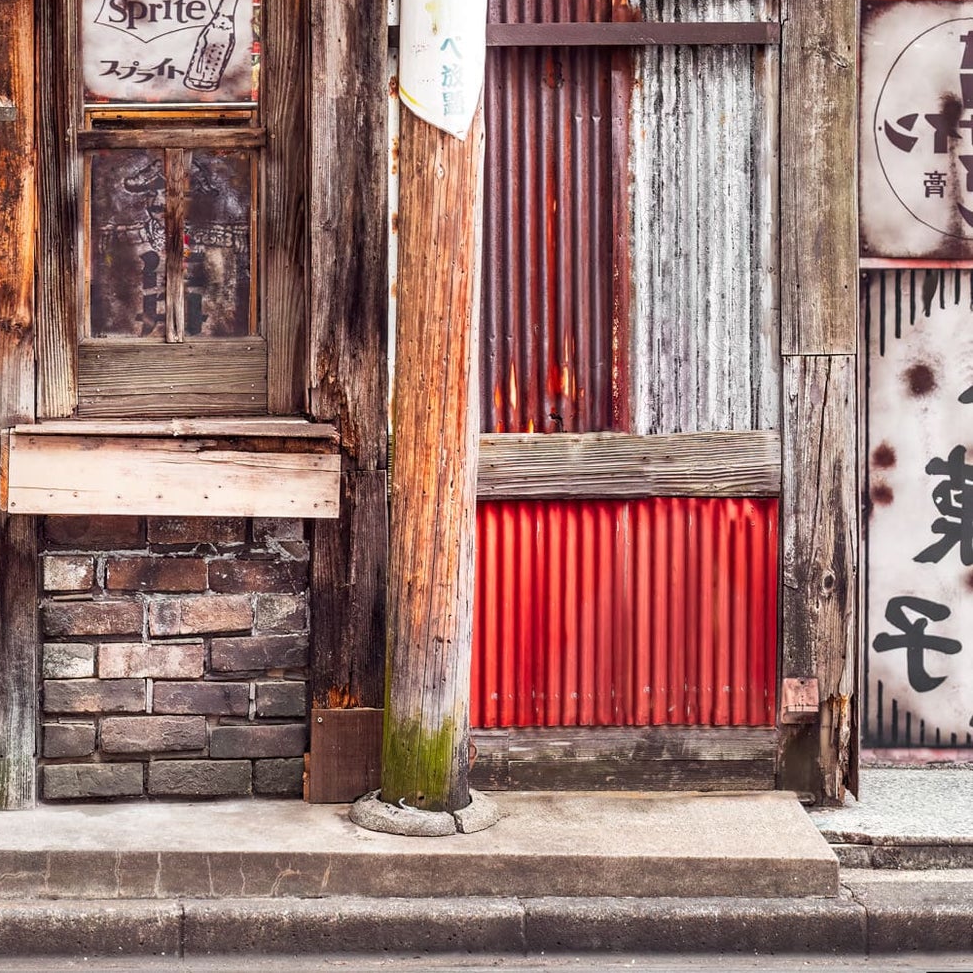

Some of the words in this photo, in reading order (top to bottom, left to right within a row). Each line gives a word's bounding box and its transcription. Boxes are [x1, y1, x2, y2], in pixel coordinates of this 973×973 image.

[99, 57, 186, 84] スプライト
